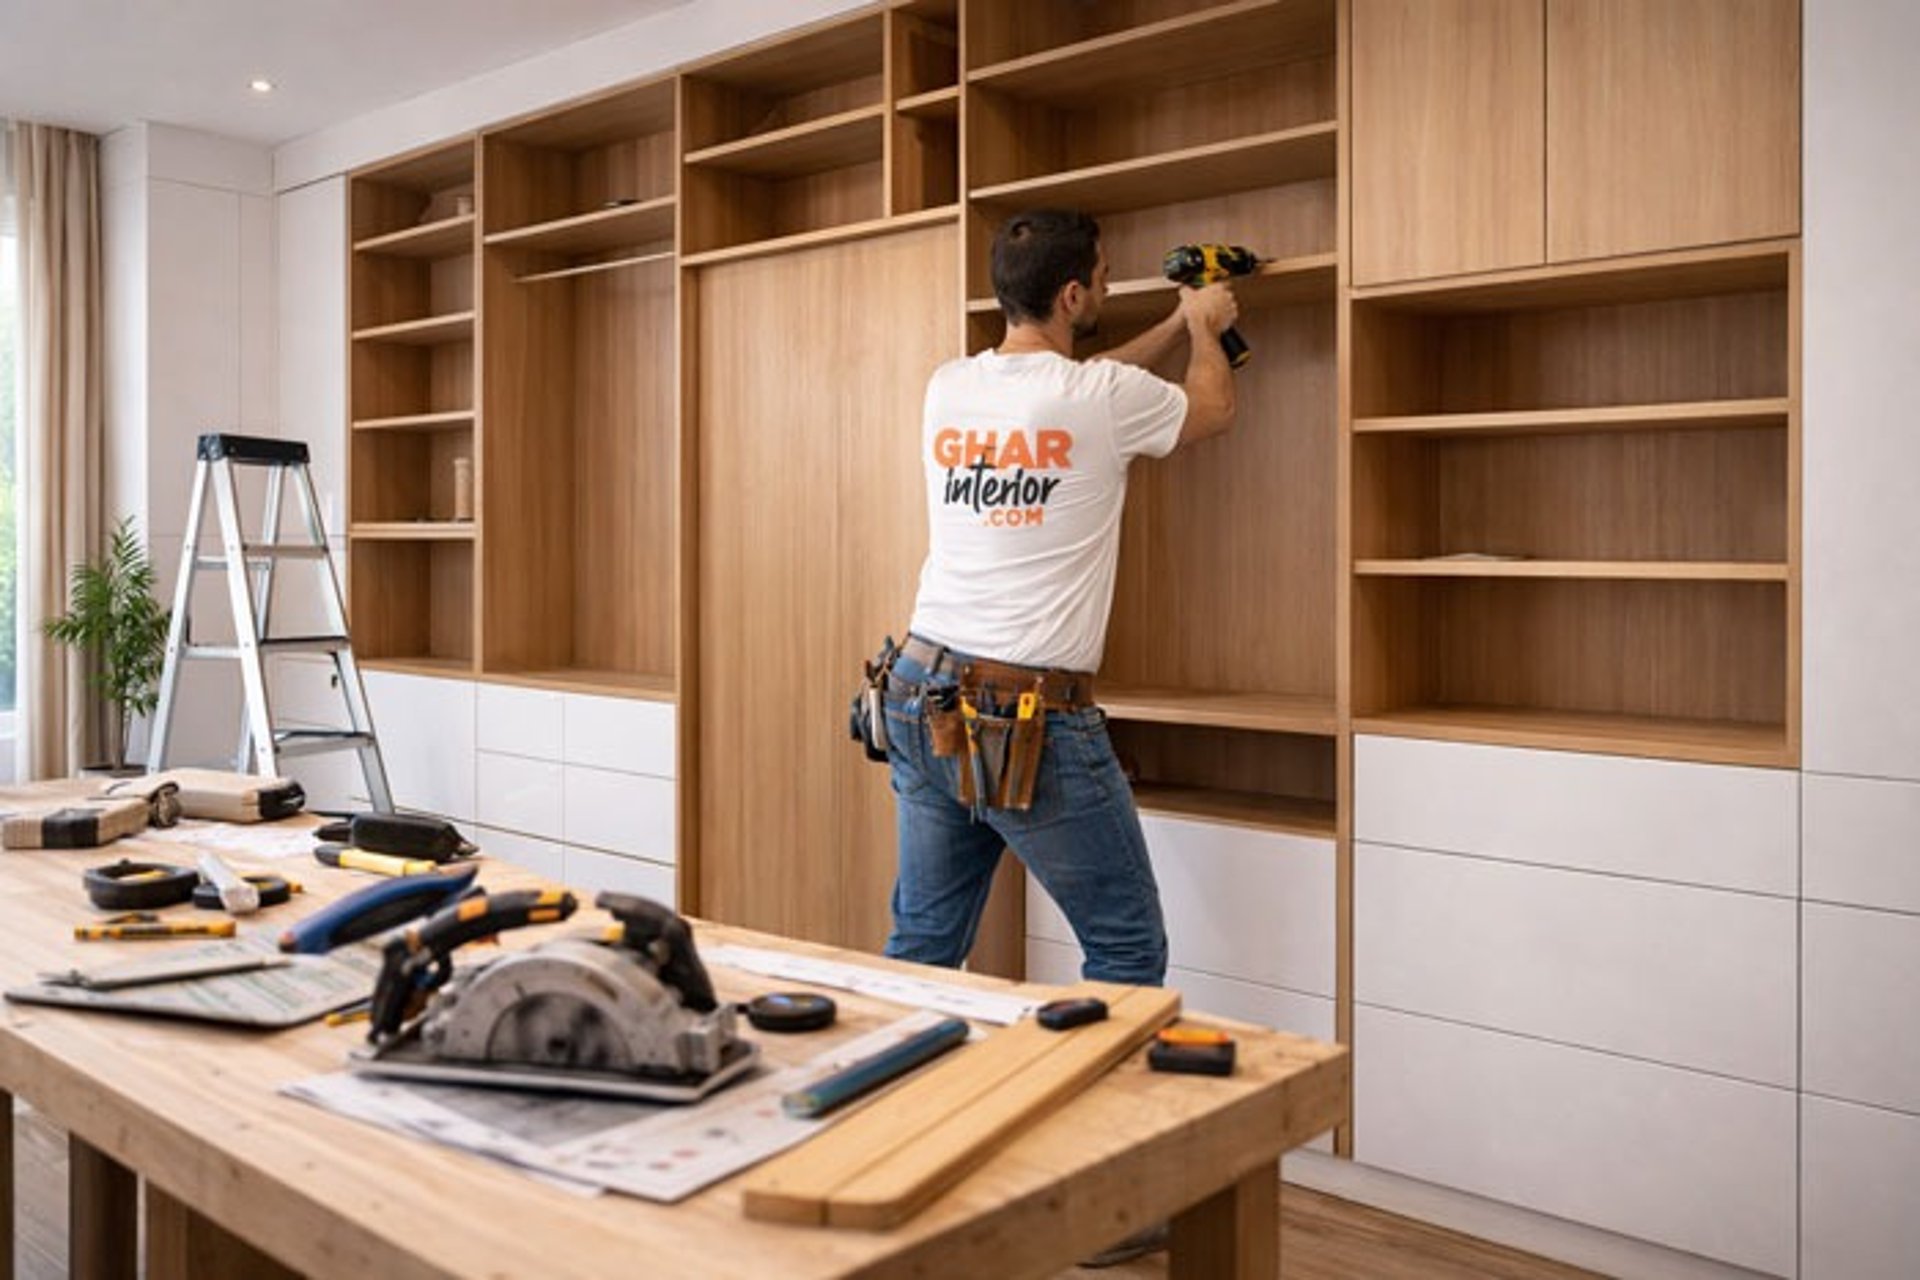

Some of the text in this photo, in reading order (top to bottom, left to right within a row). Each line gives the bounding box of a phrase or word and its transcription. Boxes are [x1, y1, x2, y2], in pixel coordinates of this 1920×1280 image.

[934, 428, 1073, 469] GHAR
[944, 453, 1061, 514] interior
[983, 507, 1044, 527] .COM
